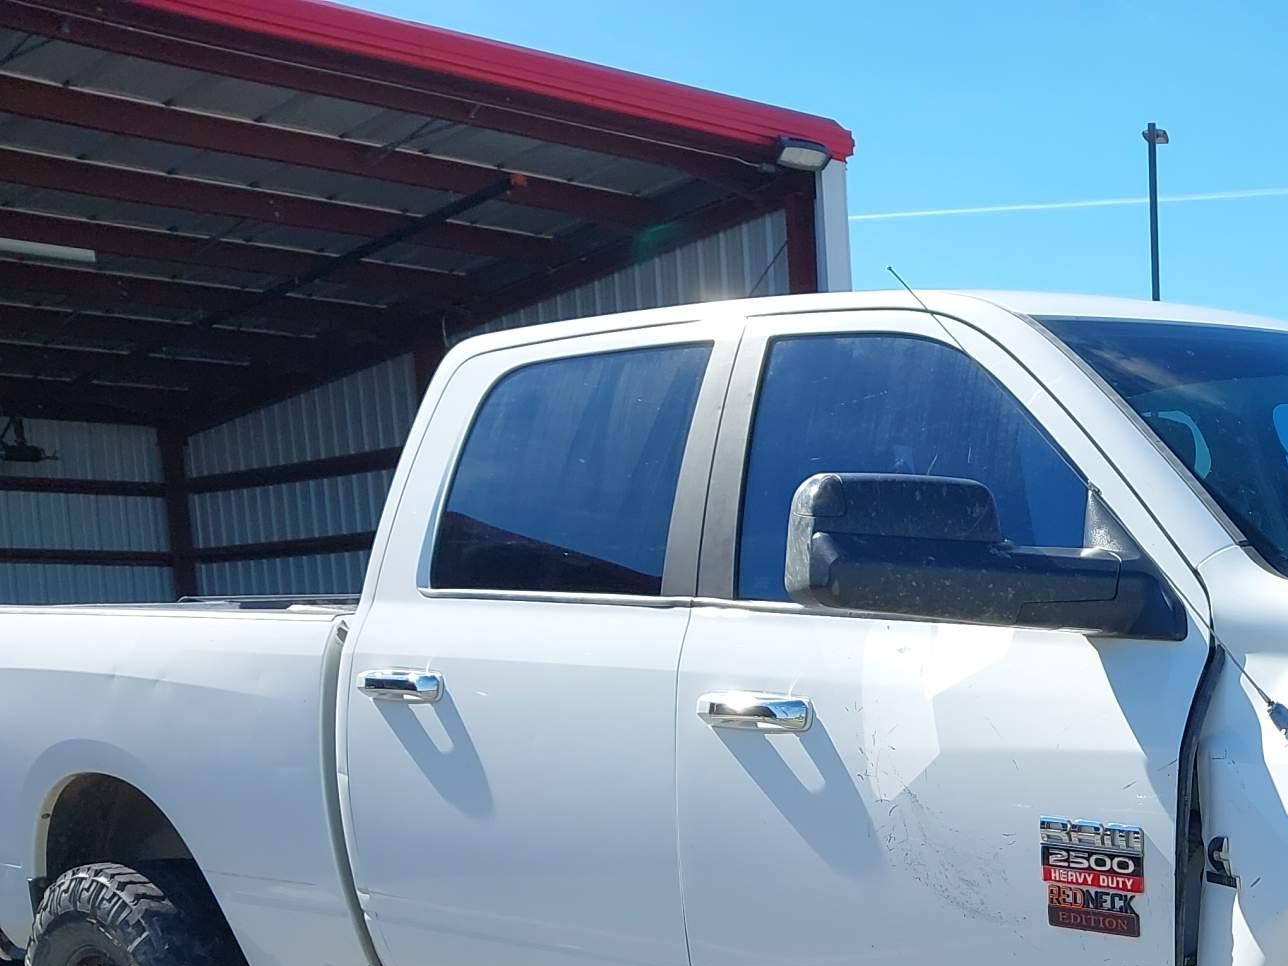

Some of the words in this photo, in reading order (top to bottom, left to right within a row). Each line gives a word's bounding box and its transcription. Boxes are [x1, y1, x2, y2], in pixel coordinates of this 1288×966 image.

[1039, 815, 1144, 852] RAM
[1049, 848, 1135, 874] 2500
[1051, 868, 1094, 885] HEAVY
[1099, 875, 1134, 890] DUTY
[1048, 884, 1136, 914] REDNECK
[1059, 911, 1128, 930] EDITION
